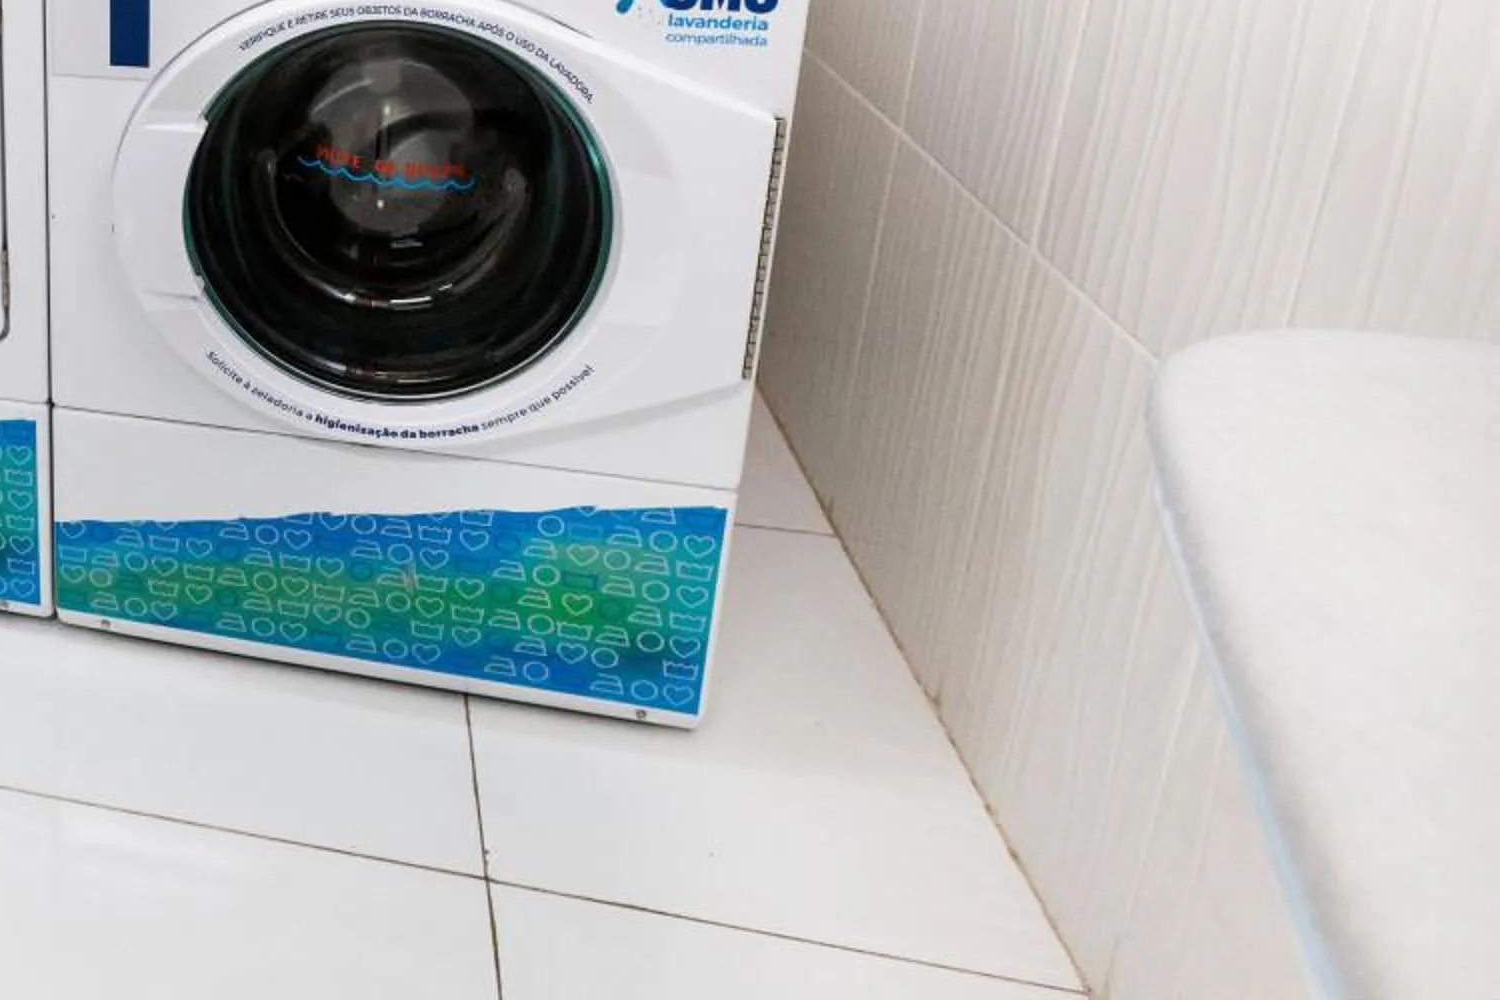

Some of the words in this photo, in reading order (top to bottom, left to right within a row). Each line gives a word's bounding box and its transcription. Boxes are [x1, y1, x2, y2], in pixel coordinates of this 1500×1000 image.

[356, 4, 401, 16] OBJETOS
[403, 6, 419, 17] DA
[420, 7, 476, 29] BORRACHA
[505, 31, 516, 42] O
[515, 37, 535, 54] USO
[534, 47, 550, 63] DA
[668, 13, 769, 31] lavanderia
[666, 33, 768, 47] compartilhada
[314, 412, 399, 440] higienização
[400, 428, 417, 440] da
[418, 422, 480, 440] borracha
[480, 408, 528, 432] sempre
[527, 396, 552, 414] que
